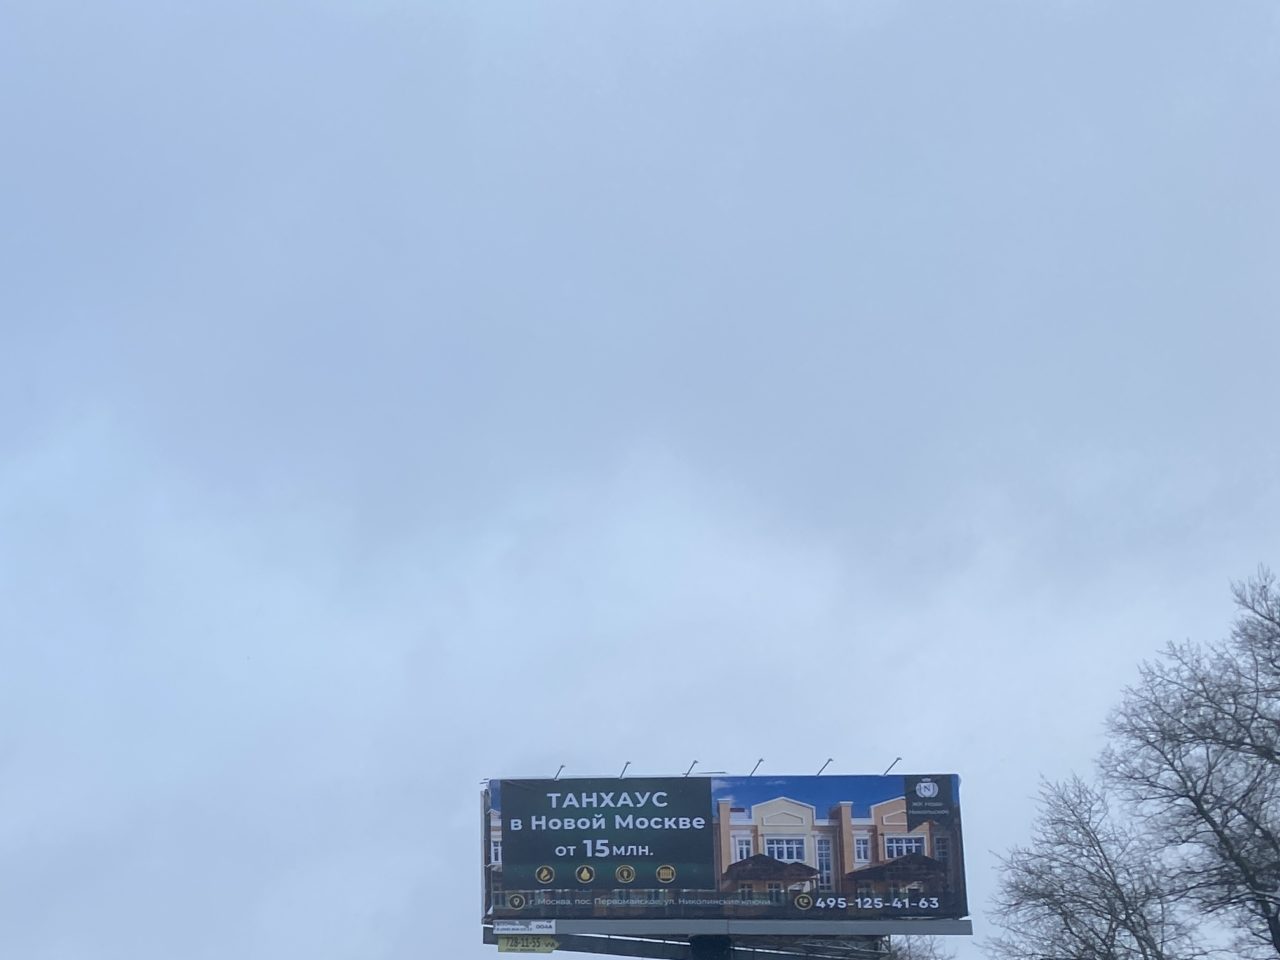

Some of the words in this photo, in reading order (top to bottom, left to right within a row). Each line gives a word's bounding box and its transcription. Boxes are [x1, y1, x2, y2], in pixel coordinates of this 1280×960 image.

[547, 791, 668, 808] ТАНХАУС
[510, 818, 522, 831] в
[531, 813, 606, 830] Новой
[615, 814, 705, 829] Москве
[555, 845, 576, 857] от
[583, 839, 609, 857] 15
[612, 844, 654, 856] млн.
[815, 897, 939, 909] 495-125-41-63
